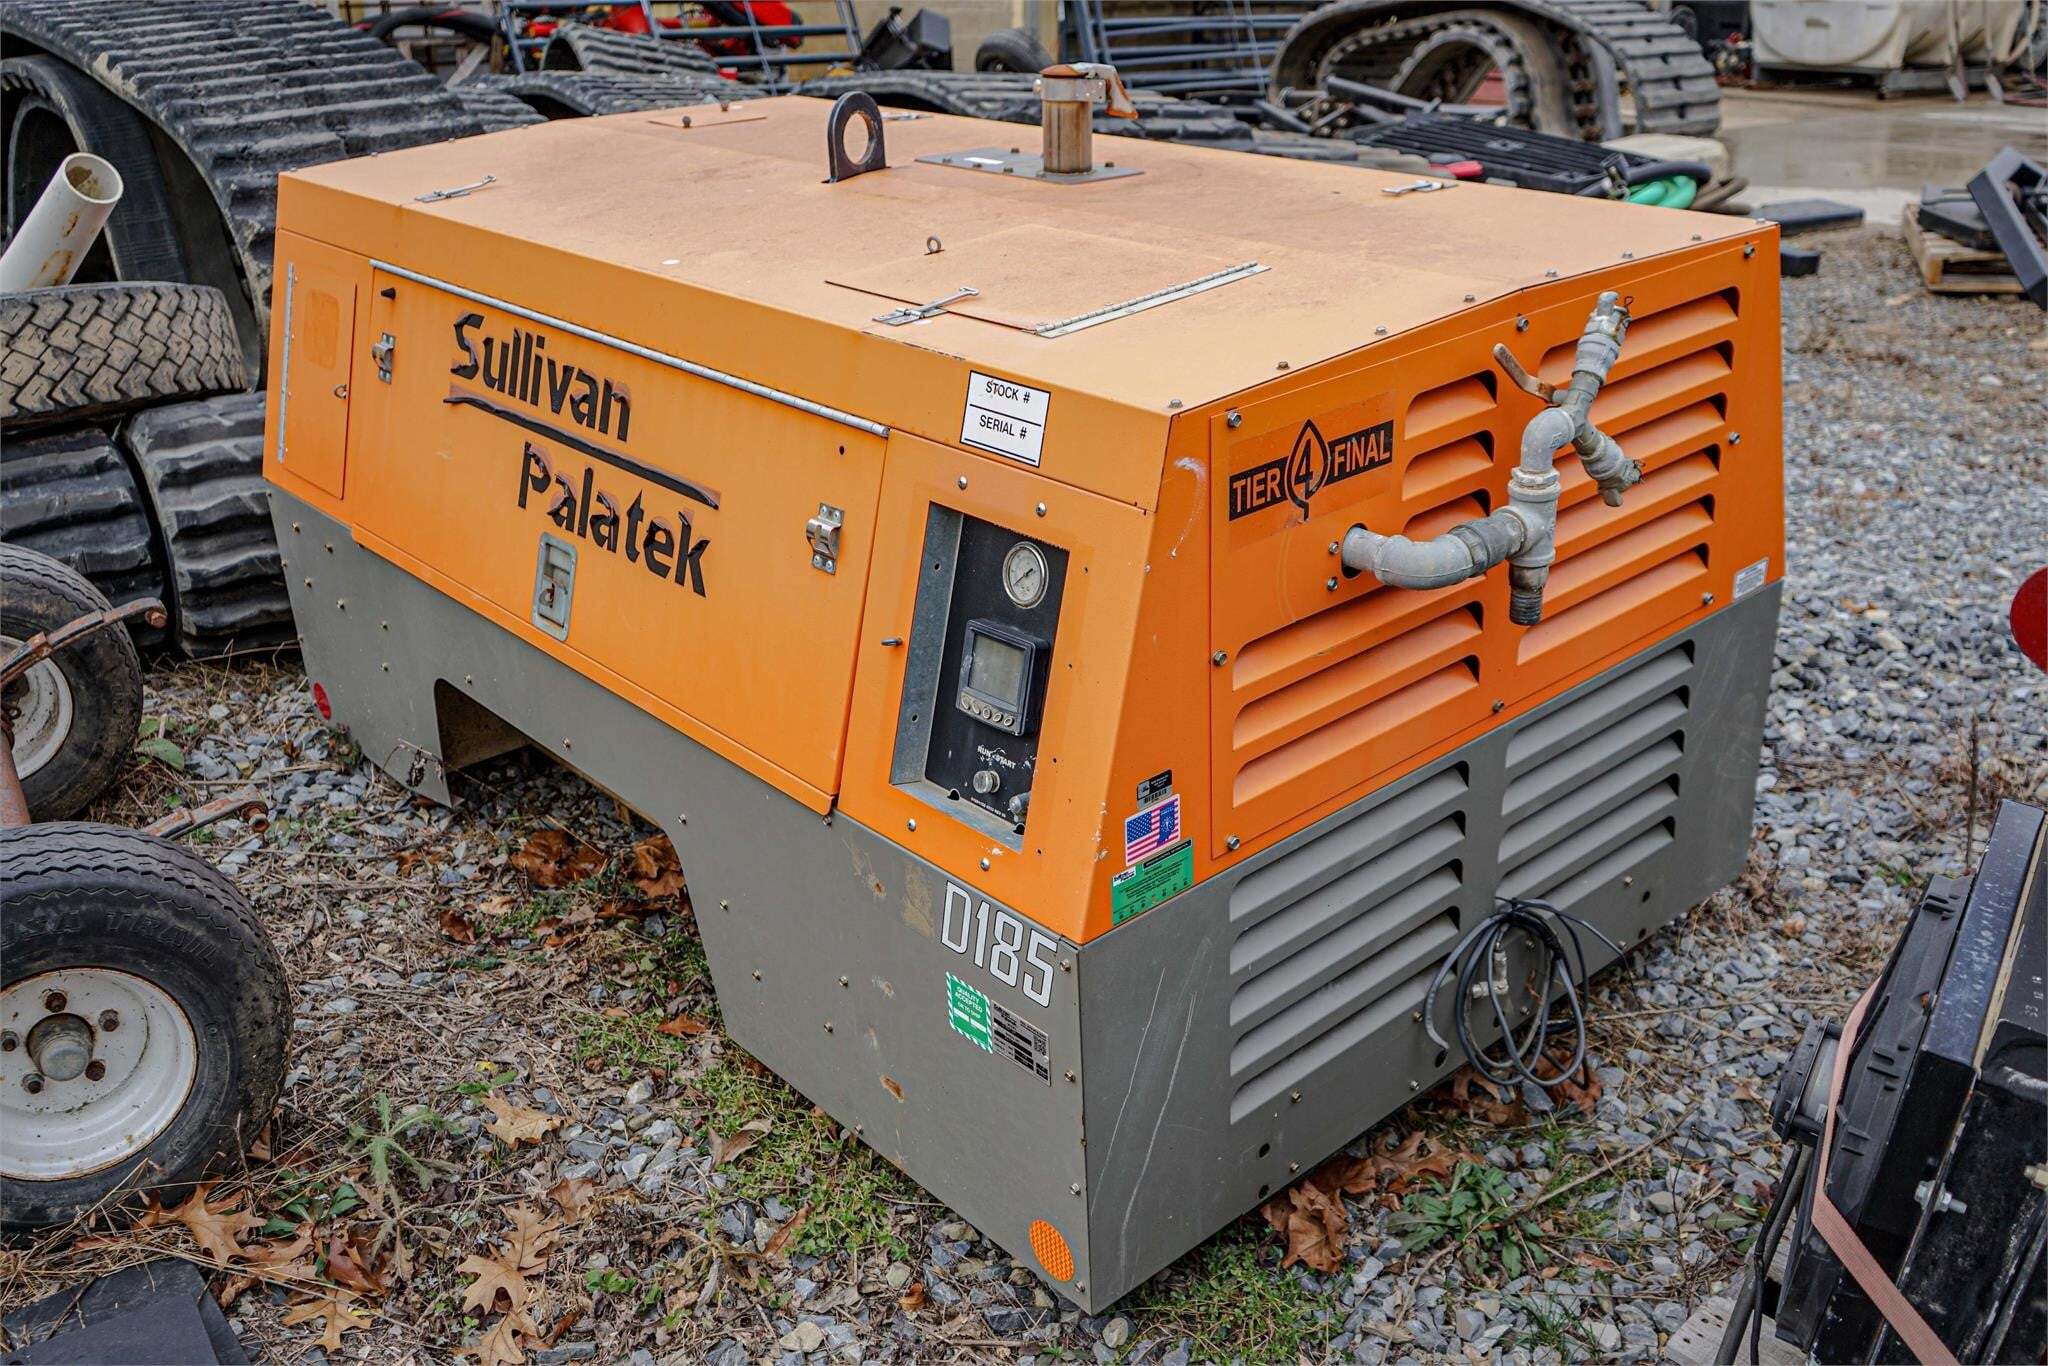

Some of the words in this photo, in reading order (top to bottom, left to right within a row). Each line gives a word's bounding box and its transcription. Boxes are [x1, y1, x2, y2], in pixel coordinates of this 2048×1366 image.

[450, 313, 631, 442] Sullivan
[979, 414, 1015, 437] SERIAL
[1019, 426, 1027, 440] #
[985, 380, 1019, 401] STOCK
[1023, 391, 1031, 404] #
[517, 441, 711, 598] Palatek
[1232, 467, 1281, 513] TIER
[1294, 438, 1314, 493] 4
[1333, 430, 1391, 477] FINAL
[941, 880, 1059, 1008] D185
